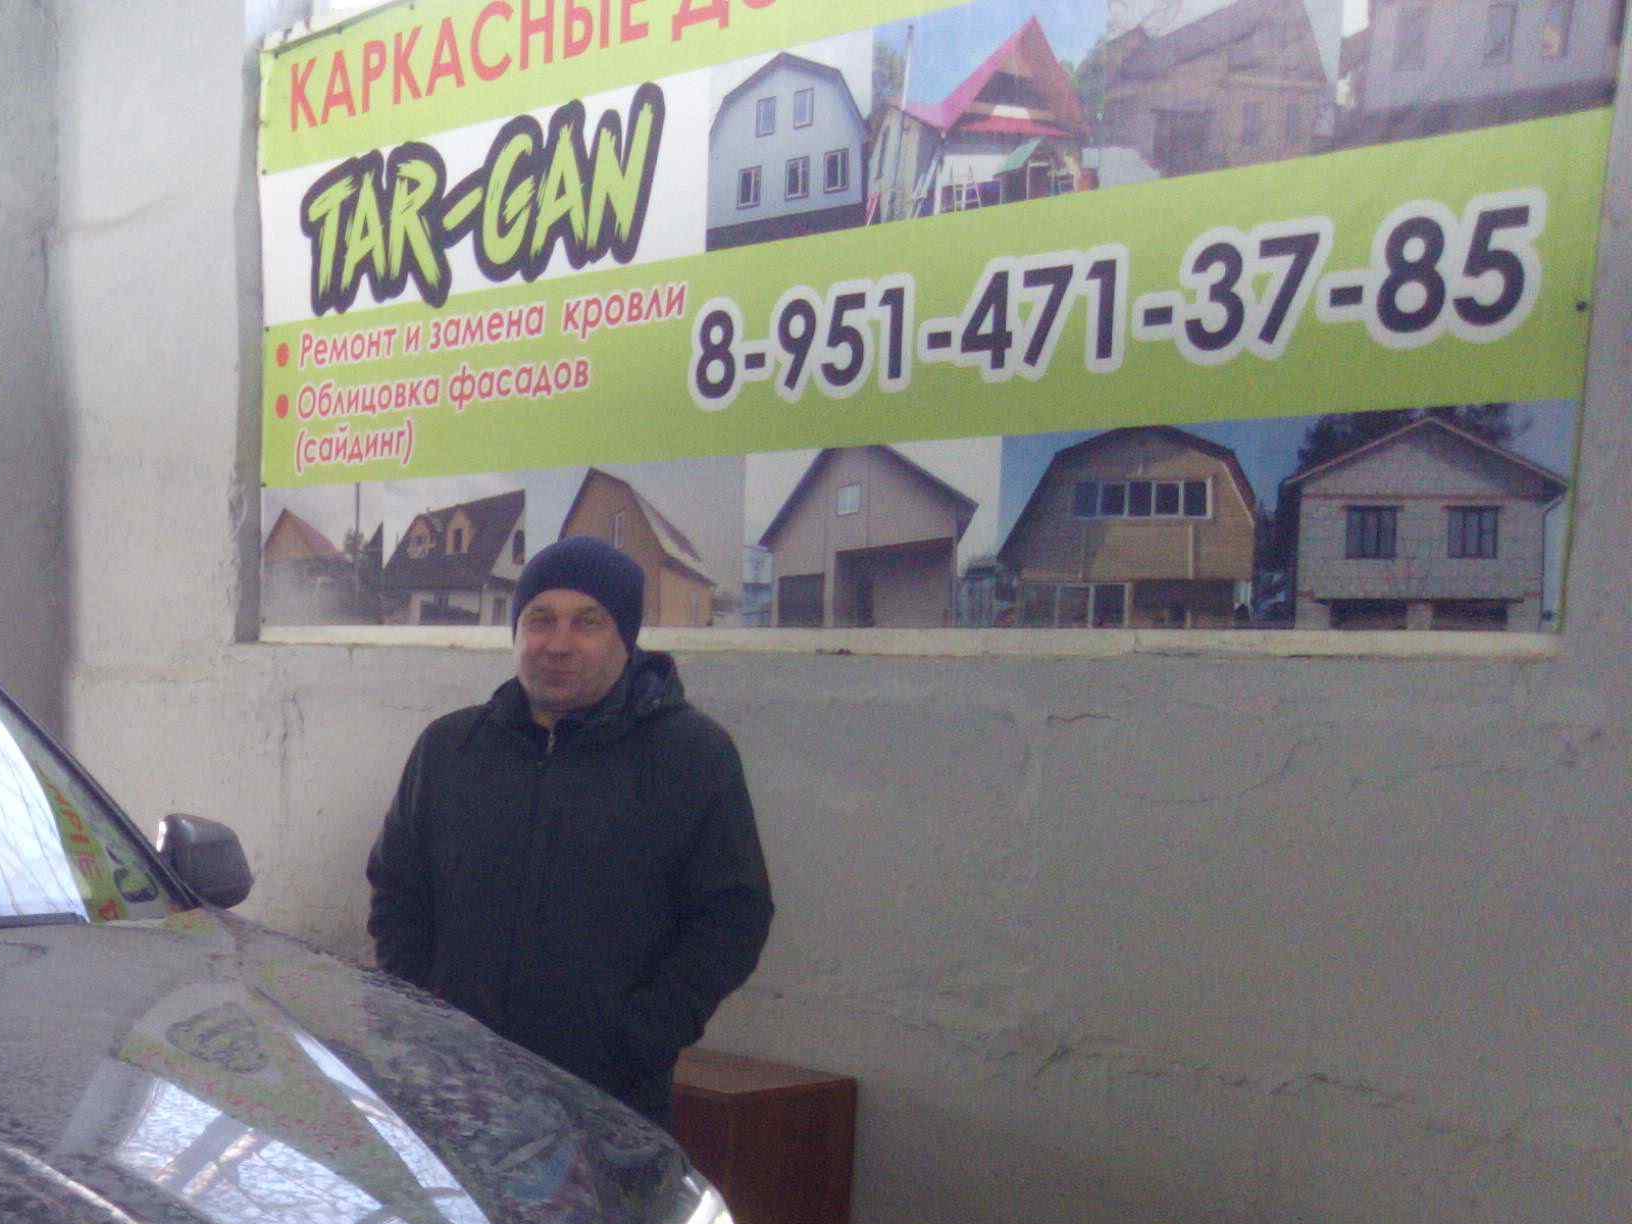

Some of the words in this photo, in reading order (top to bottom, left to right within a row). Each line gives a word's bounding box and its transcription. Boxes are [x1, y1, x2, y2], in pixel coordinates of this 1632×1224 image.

[289, 0, 649, 132] КАРКАСНЫЕ
[301, 82, 665, 316] TAR-GAN
[299, 322, 396, 368] Ремонт
[404, 325, 421, 348] и
[430, 303, 544, 348] замена
[562, 283, 688, 335] кровли
[695, 204, 1534, 402] 8-951-471-37-85
[297, 378, 439, 420] Облицовка
[449, 357, 591, 407] фасадов
[295, 423, 415, 472] (сайдинг)
